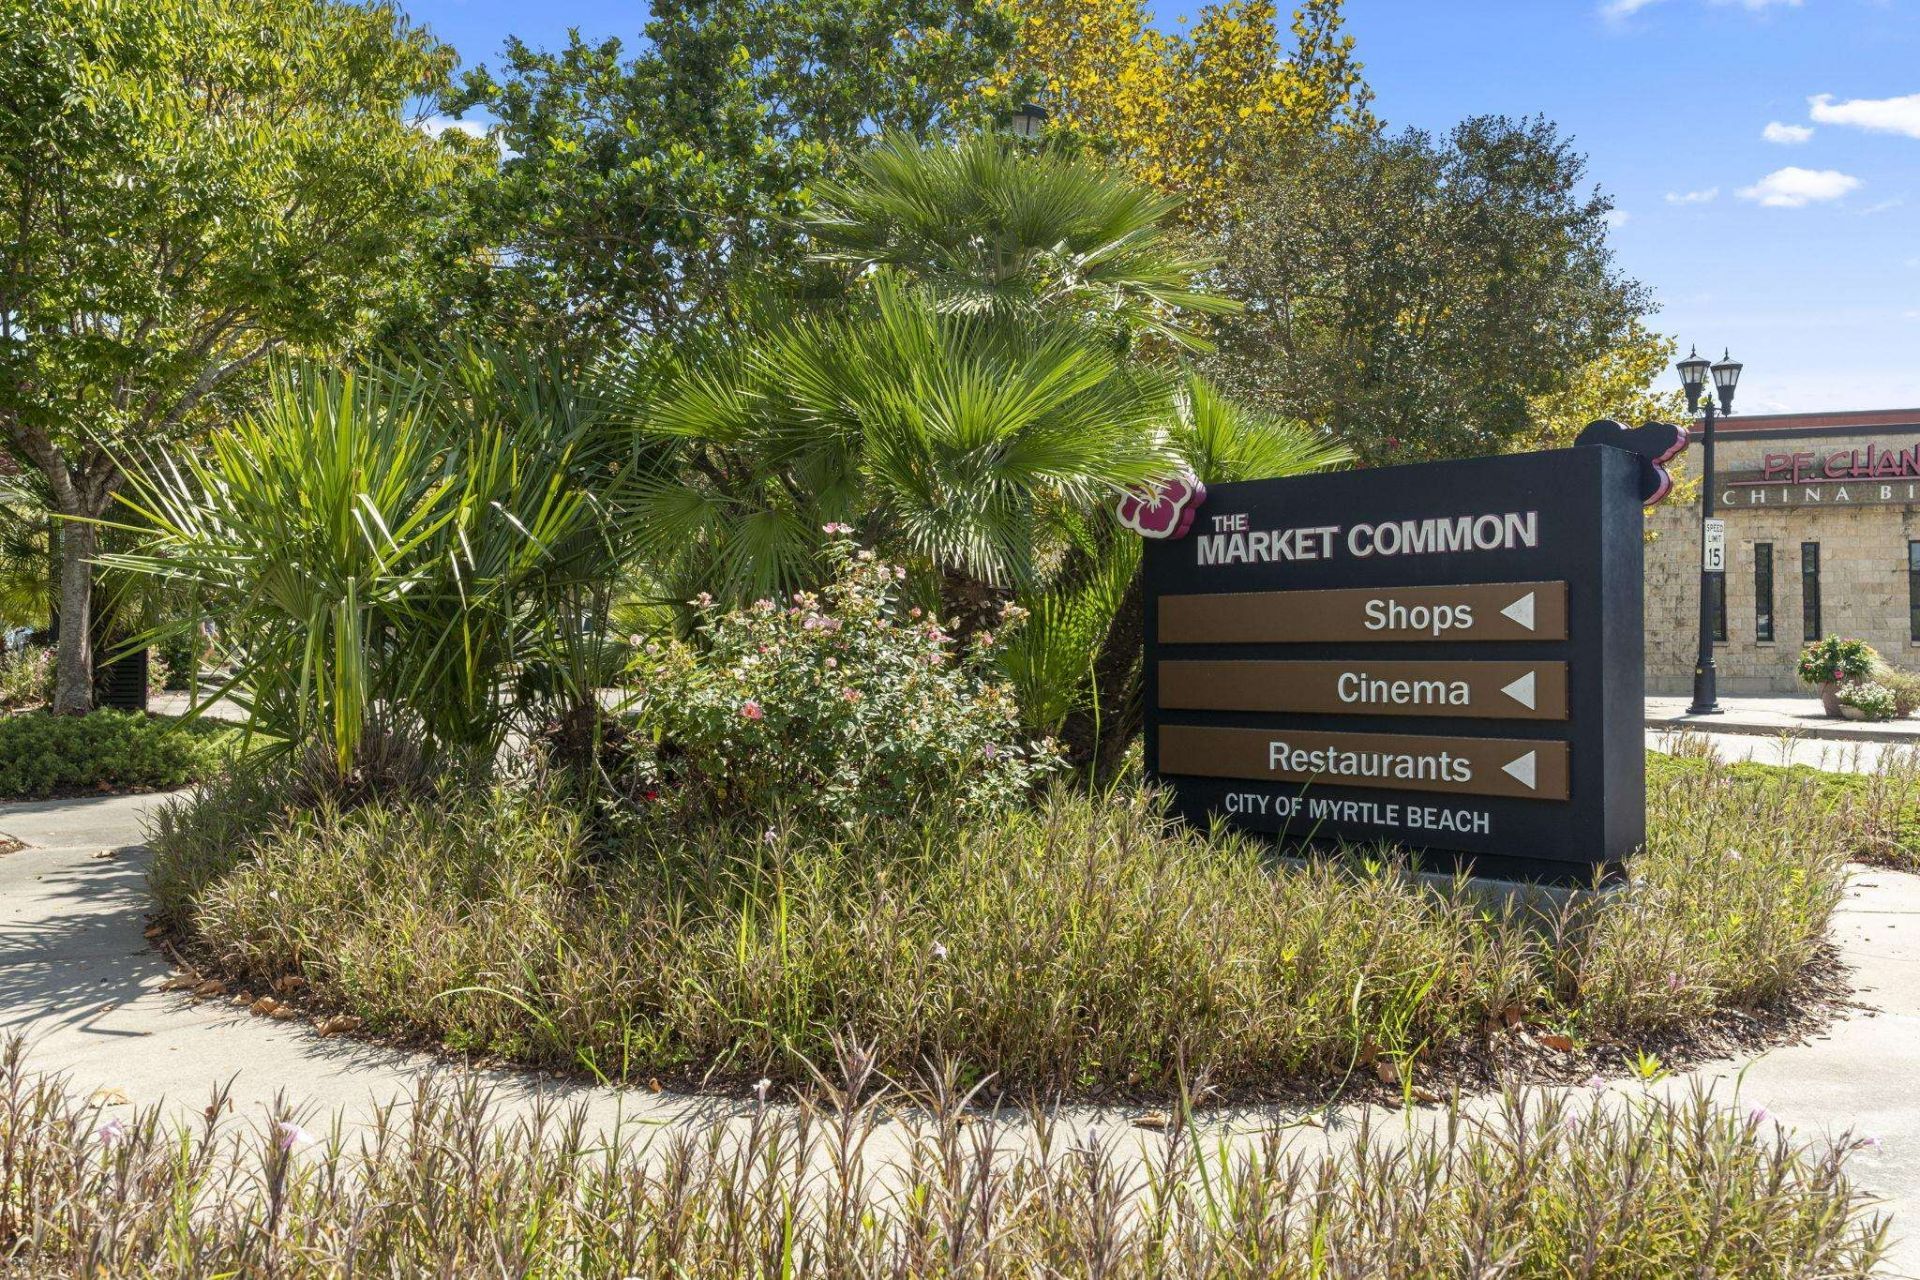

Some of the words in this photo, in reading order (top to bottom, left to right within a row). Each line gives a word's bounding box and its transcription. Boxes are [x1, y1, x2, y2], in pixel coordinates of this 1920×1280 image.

[1722, 486, 1850, 505] CHINA
[1197, 525, 1340, 566] MARKET
[1347, 512, 1538, 557] COMMON
[1212, 513, 1248, 533] THE
[1706, 524, 1723, 532] SPEED
[1708, 548, 1721, 567] 15
[1364, 598, 1473, 636] Shops
[1337, 672, 1471, 705] Cinema
[1269, 741, 1472, 783] Restaurants
[1225, 793, 1269, 814] CITY
[1275, 797, 1302, 816] OF
[1309, 799, 1398, 825] MYRTLE
[1407, 807, 1490, 834] BEACH
